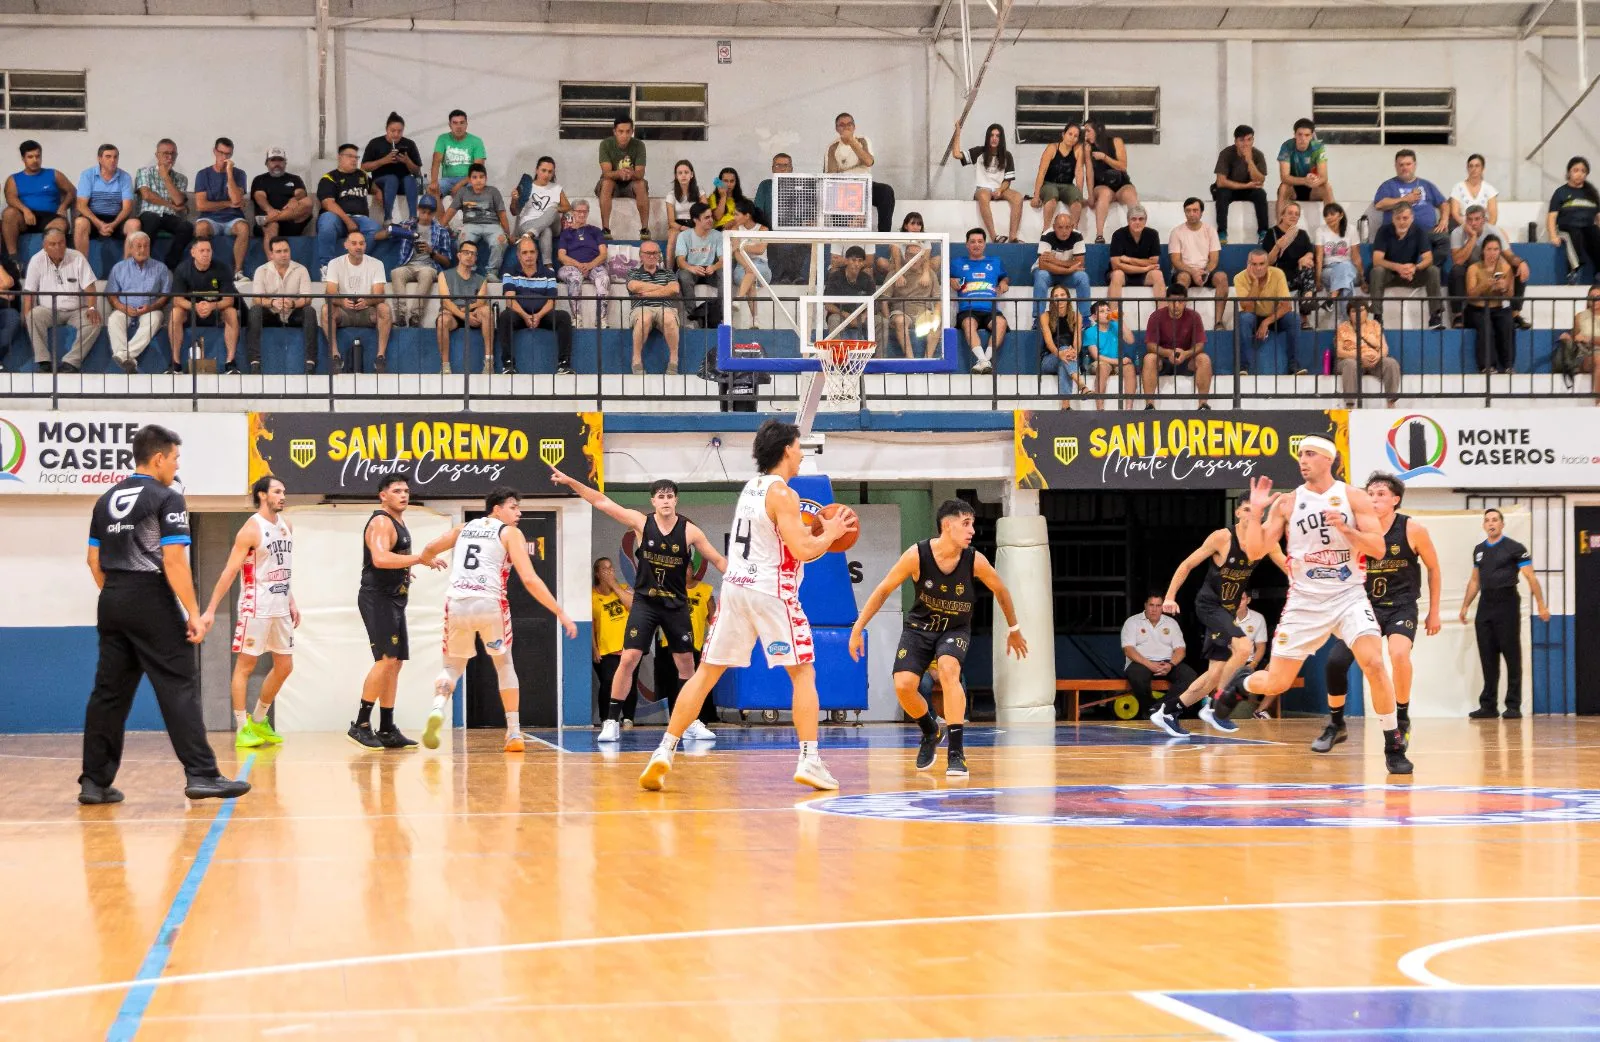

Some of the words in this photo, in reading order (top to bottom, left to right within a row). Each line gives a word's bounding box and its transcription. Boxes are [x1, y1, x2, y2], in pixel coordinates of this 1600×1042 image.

[38, 422, 139, 443] MONTE
[328, 423, 388, 461] SAN
[395, 420, 529, 461] LORENZO
[1089, 421, 1145, 459] SAN
[1153, 418, 1279, 458] LORENZO
[1458, 429, 1530, 445] MONTE
[1102, 447, 1167, 483] Monte
[1171, 446, 1257, 480] Caseros
[1459, 449, 1555, 465] CASEROS
[39, 471, 78, 484] hacia
[340, 450, 411, 487] Monte
[414, 449, 505, 485] Caseros
[735, 518, 751, 560] 4
[1320, 529, 1330, 545] 5
[267, 540, 292, 556] TOKIO
[464, 544, 481, 569] 6
[276, 553, 284, 565] 13
[655, 568, 666, 587] 7
[1364, 609, 1375, 622] 5
